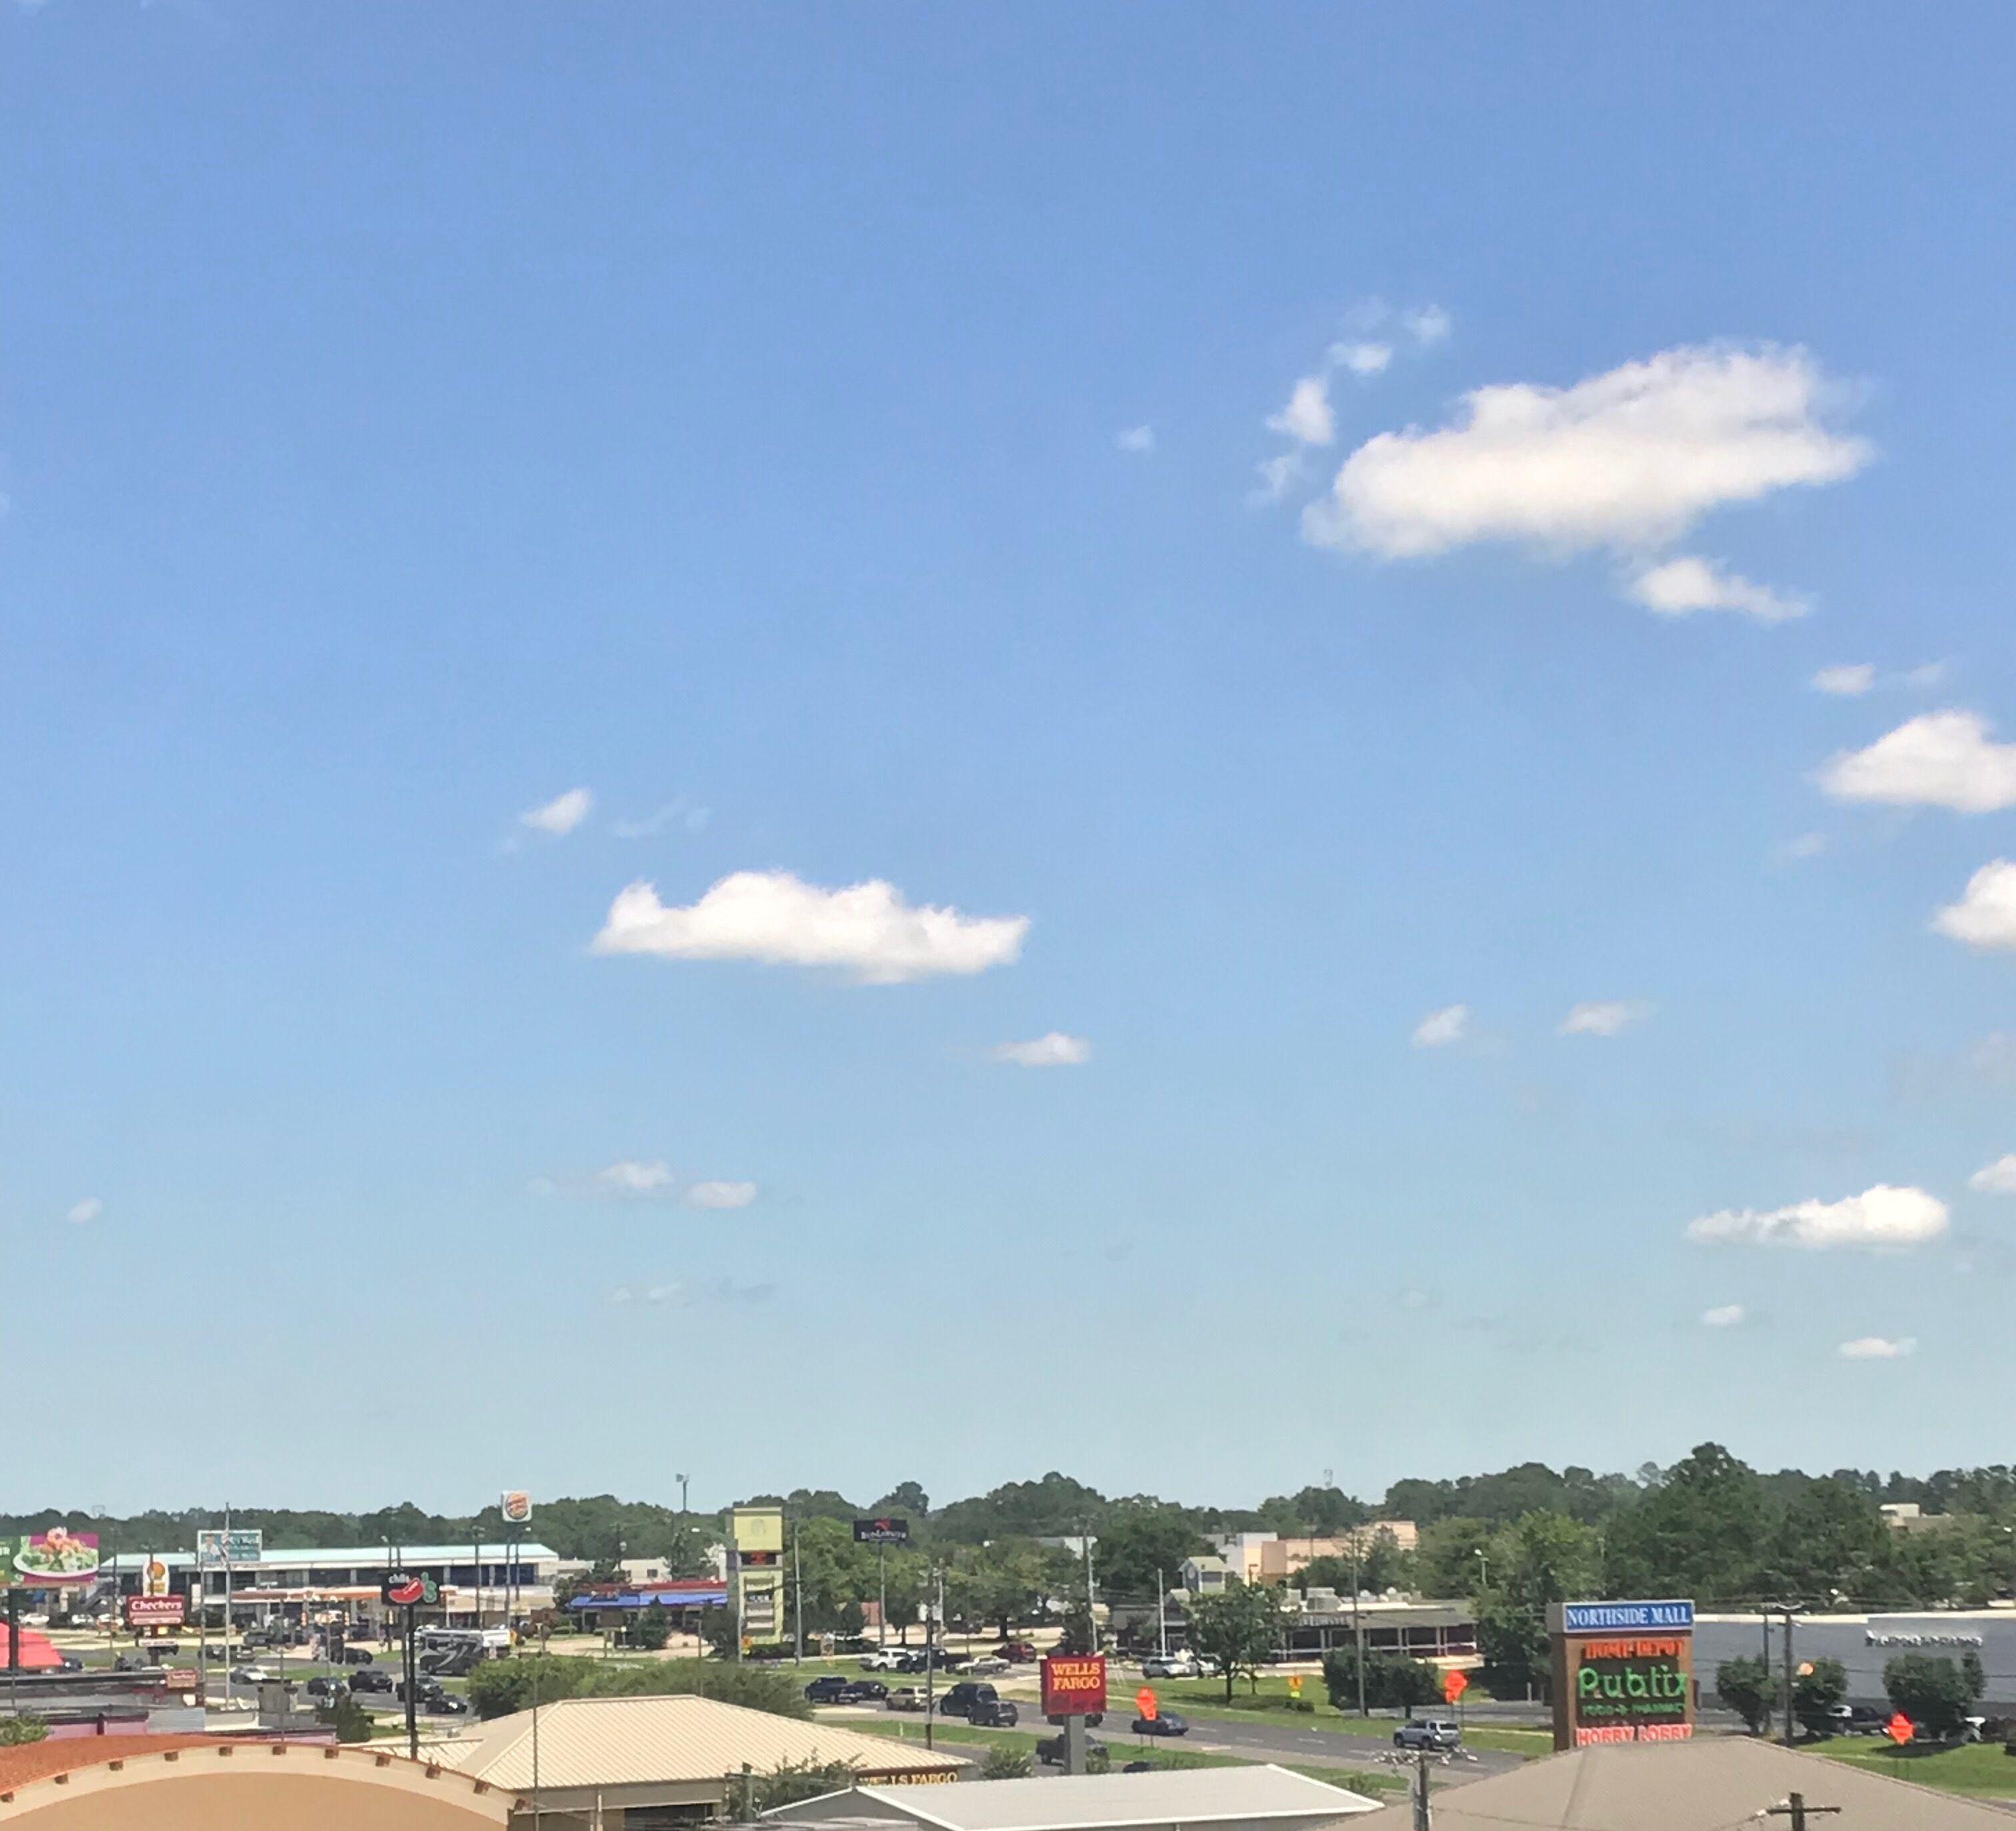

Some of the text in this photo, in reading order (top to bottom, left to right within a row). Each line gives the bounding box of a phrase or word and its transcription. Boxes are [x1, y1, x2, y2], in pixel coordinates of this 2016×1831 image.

[131, 1601, 182, 1610] Checkers
[1567, 1606, 1690, 1626] NORTHSIDE MALL
[1051, 1662, 1101, 1676] WELLS
[1053, 1676, 1101, 1690] FARGO
[1579, 1665, 1688, 1699] Publix
[1576, 1724, 1692, 1747] HOBBY LOBBY
[911, 1772, 957, 1784] FARGO
